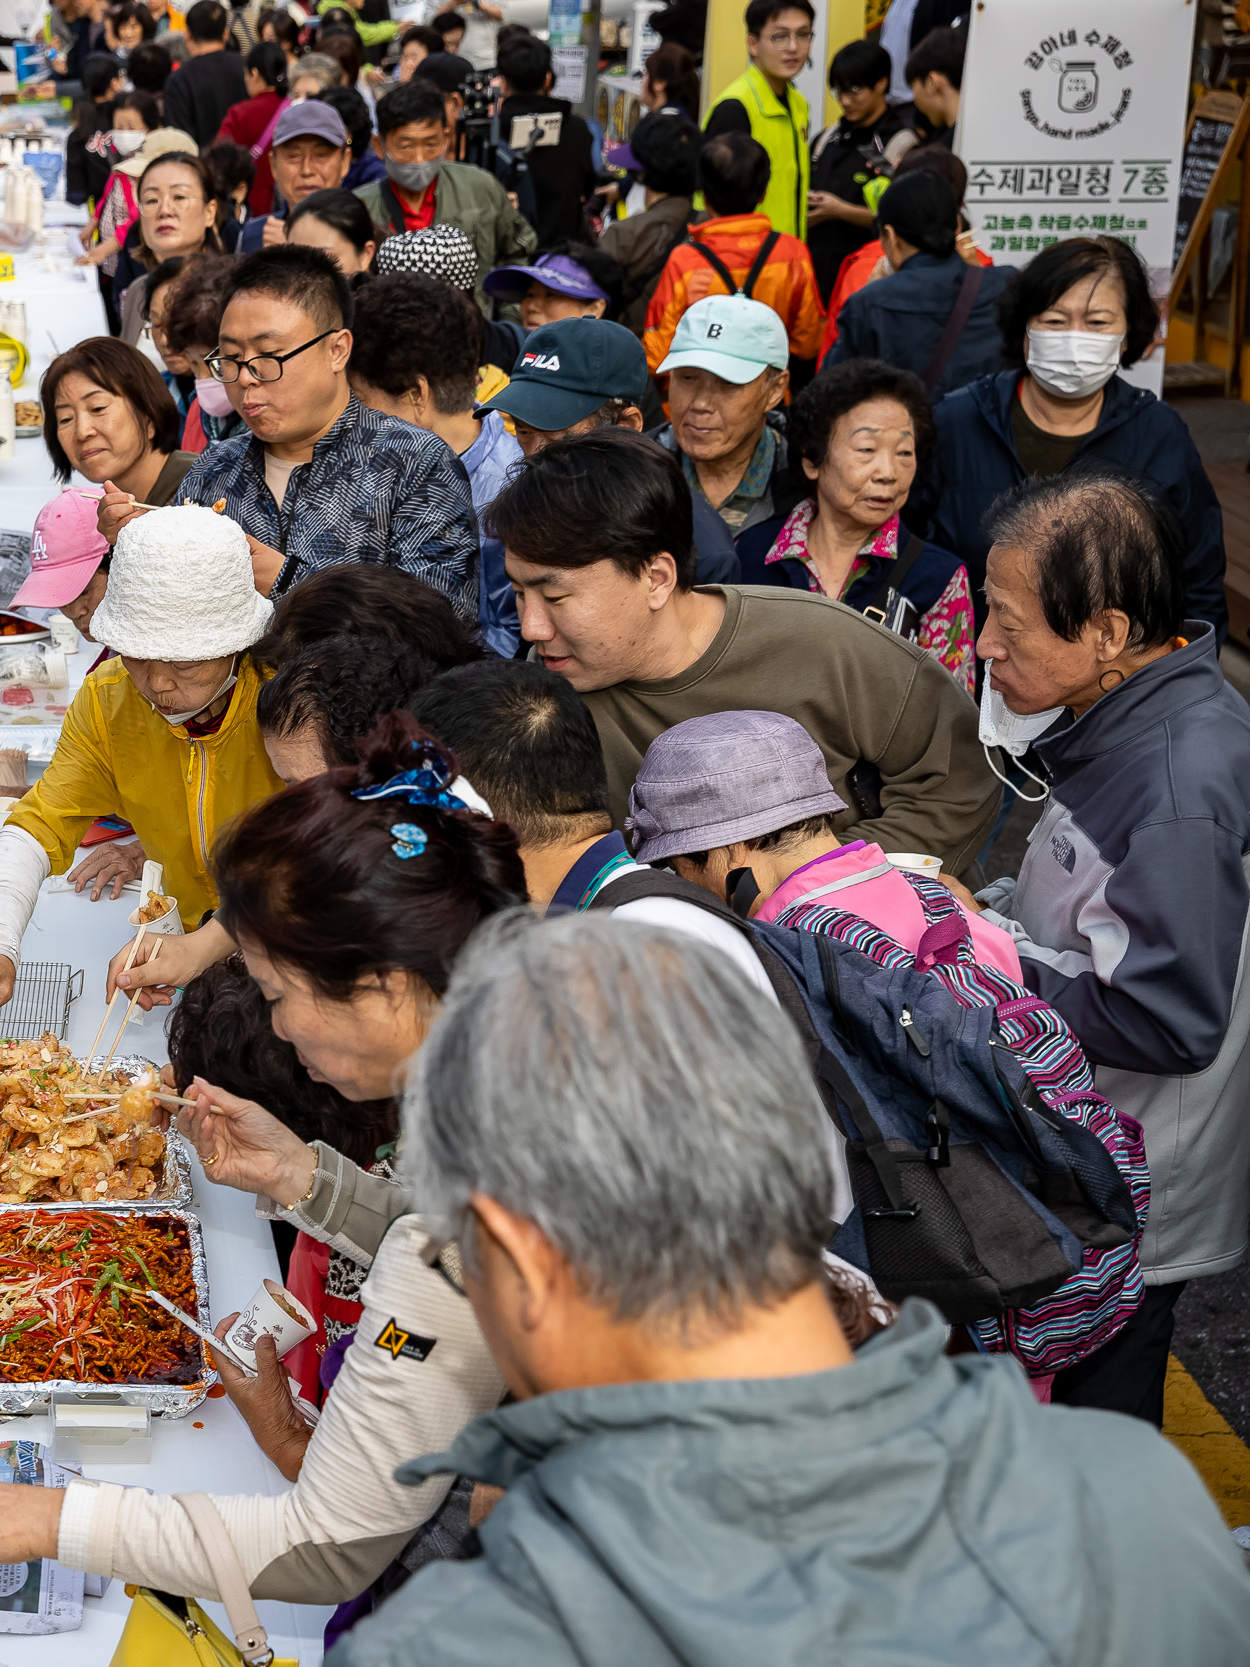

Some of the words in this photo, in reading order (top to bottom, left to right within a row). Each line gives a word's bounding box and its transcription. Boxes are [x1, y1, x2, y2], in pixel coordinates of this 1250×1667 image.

[969, 166, 1111, 197] 수제과일청
[1122, 165, 1169, 196] 7종
[520, 352, 560, 371] FILA
[32, 530, 48, 561] LA
